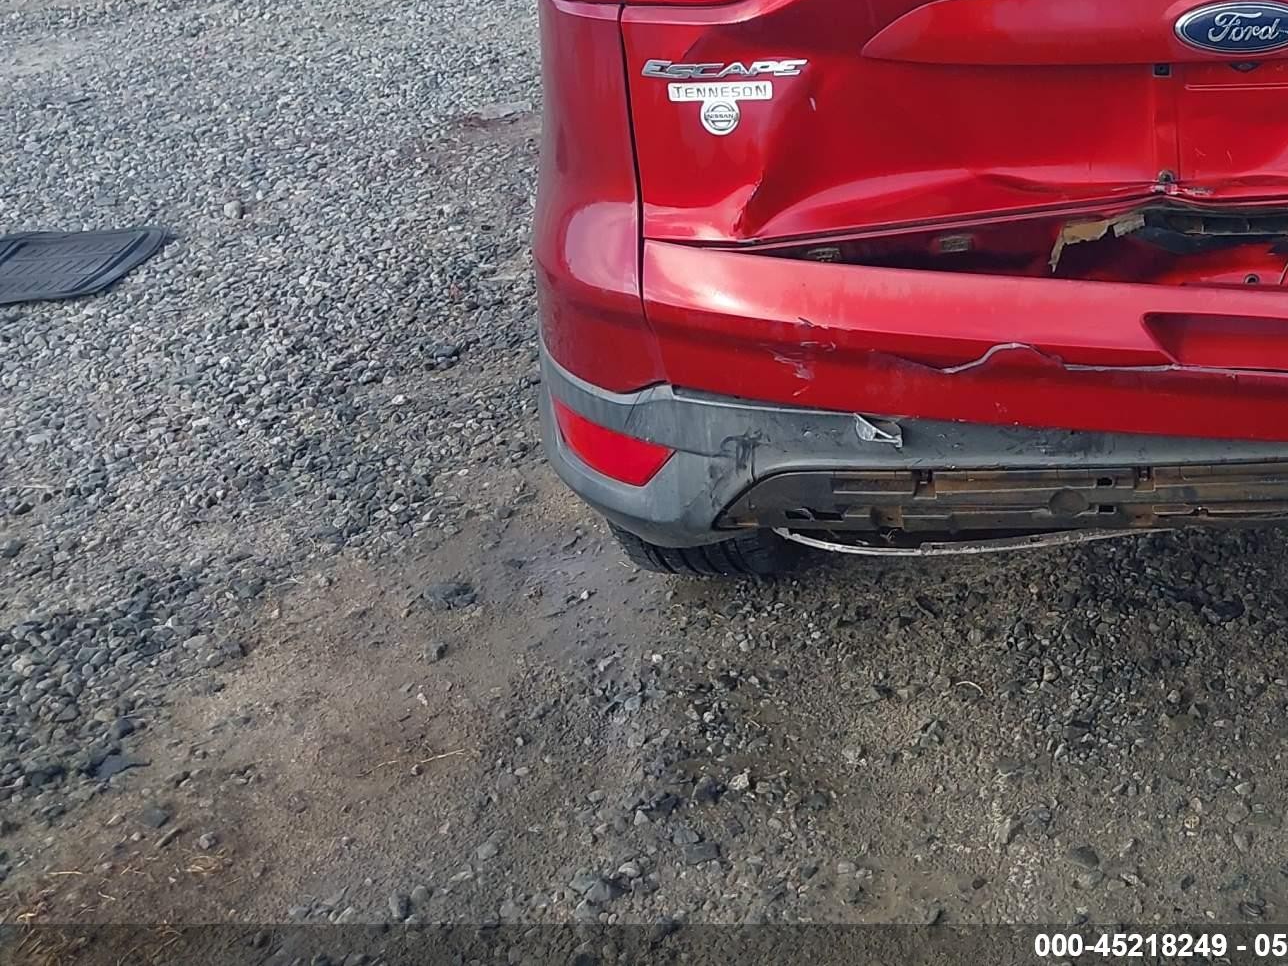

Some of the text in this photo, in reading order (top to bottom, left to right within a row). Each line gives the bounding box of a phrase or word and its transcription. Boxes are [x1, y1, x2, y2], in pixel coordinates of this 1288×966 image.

[1208, 11, 1281, 42] Ford
[641, 59, 808, 79] ESCAPE
[672, 84, 768, 99] TENNESON
